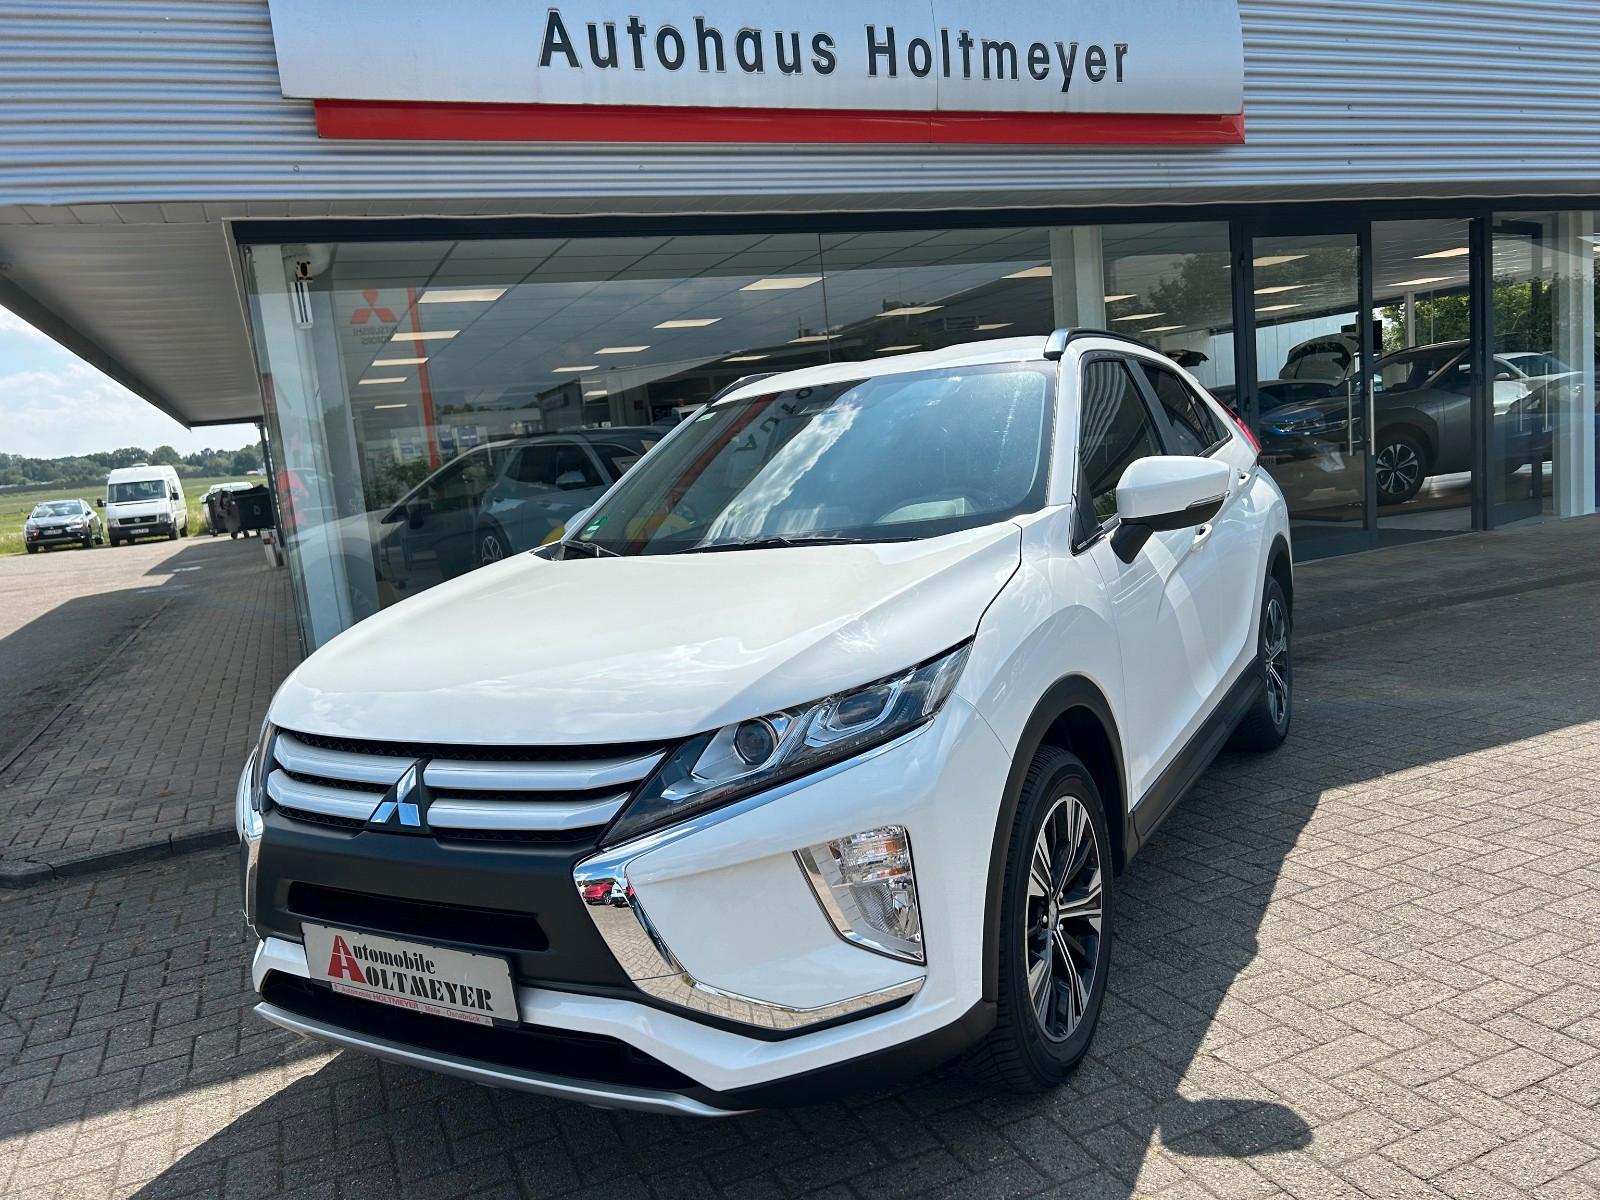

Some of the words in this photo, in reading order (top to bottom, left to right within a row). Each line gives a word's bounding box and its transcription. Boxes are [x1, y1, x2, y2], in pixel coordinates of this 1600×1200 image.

[539, 8, 836, 77] Autohaus
[865, 24, 1128, 93] Holtmeyer
[373, 993, 419, 1010] HOLTMEYER
